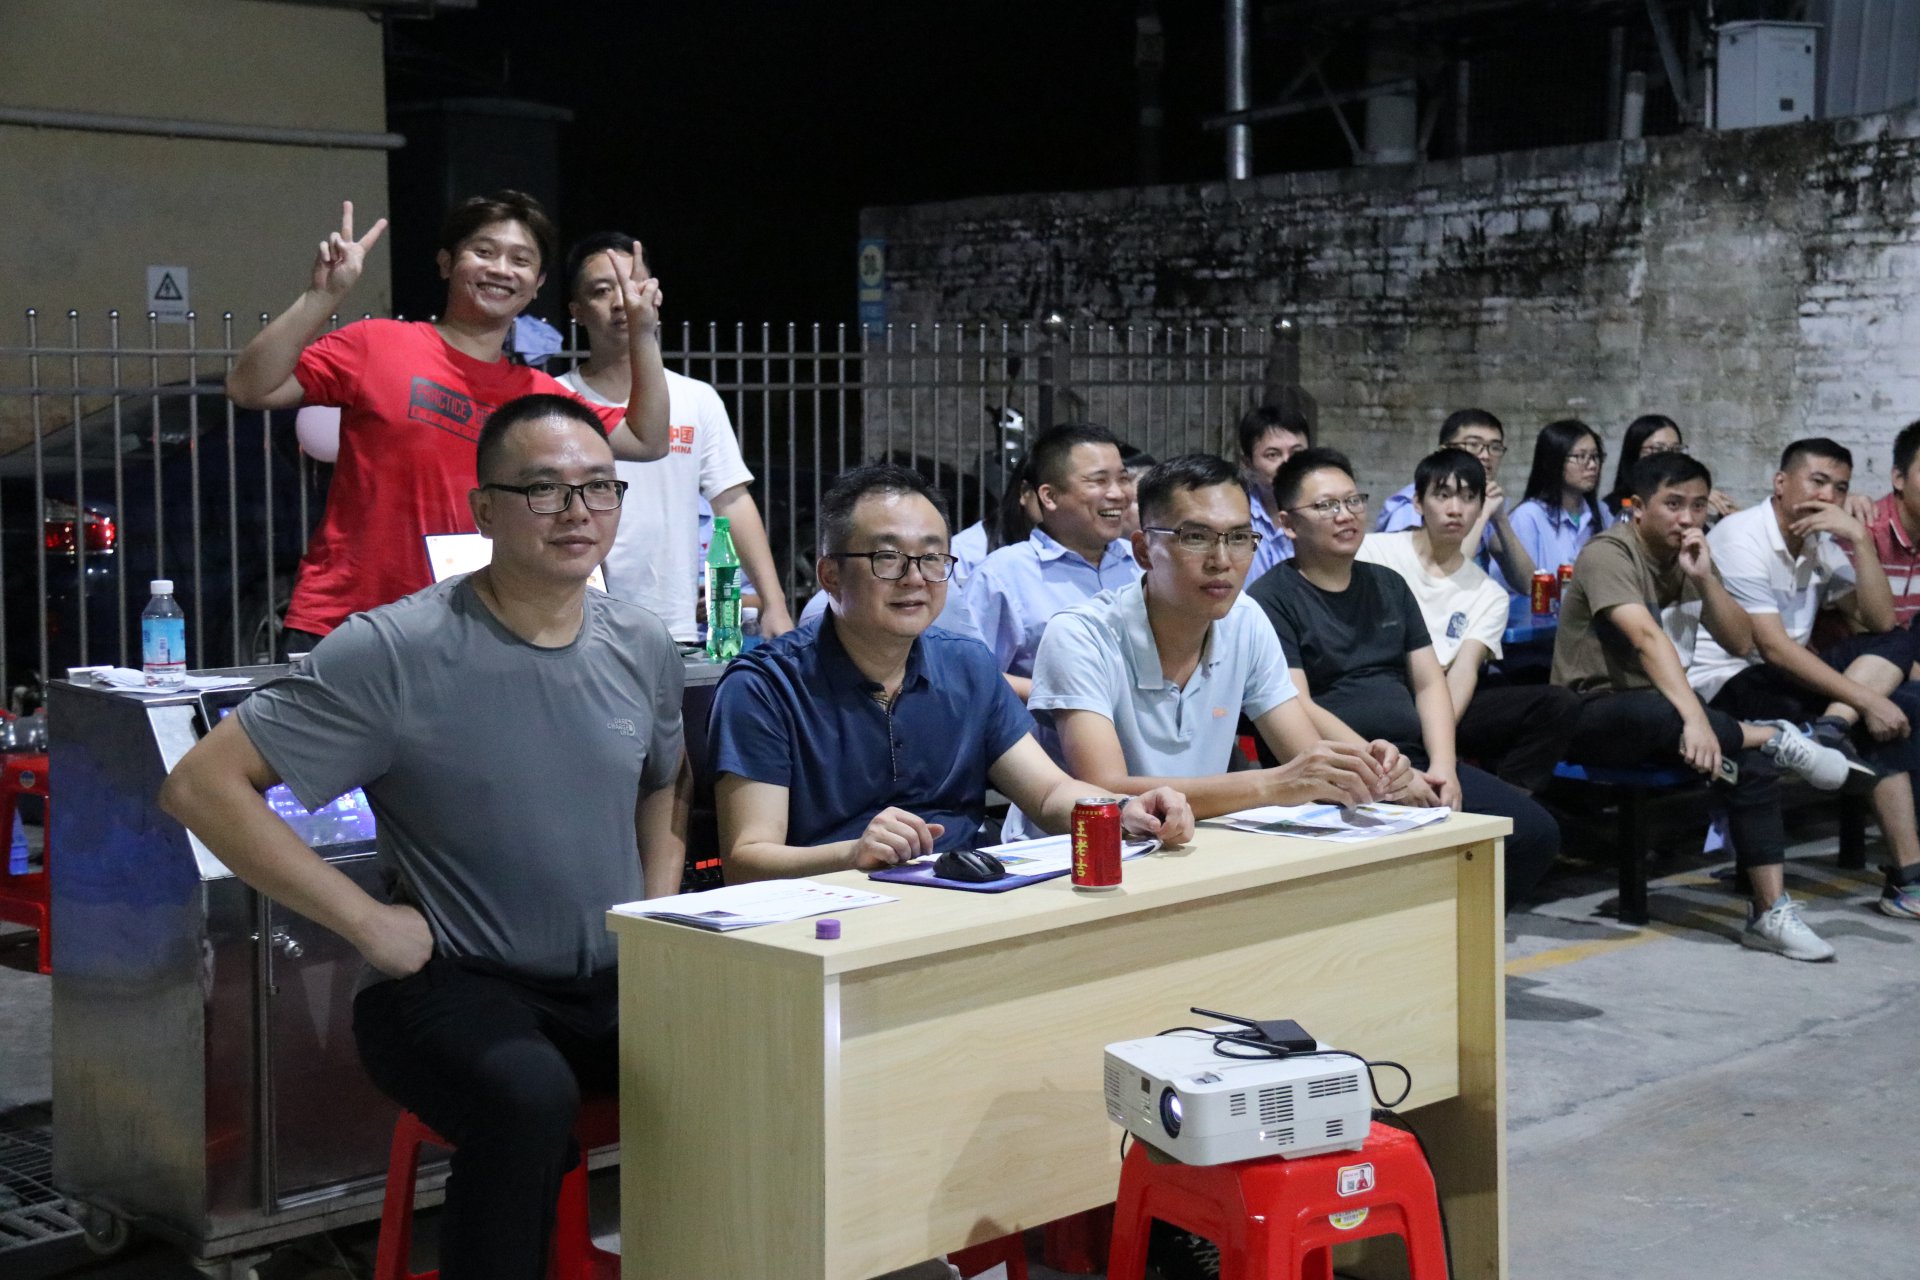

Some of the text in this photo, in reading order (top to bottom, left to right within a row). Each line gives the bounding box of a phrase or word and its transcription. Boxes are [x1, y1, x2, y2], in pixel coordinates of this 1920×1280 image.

[670, 445, 692, 454] HINA
[1075, 820, 1088, 877] 王老吉
